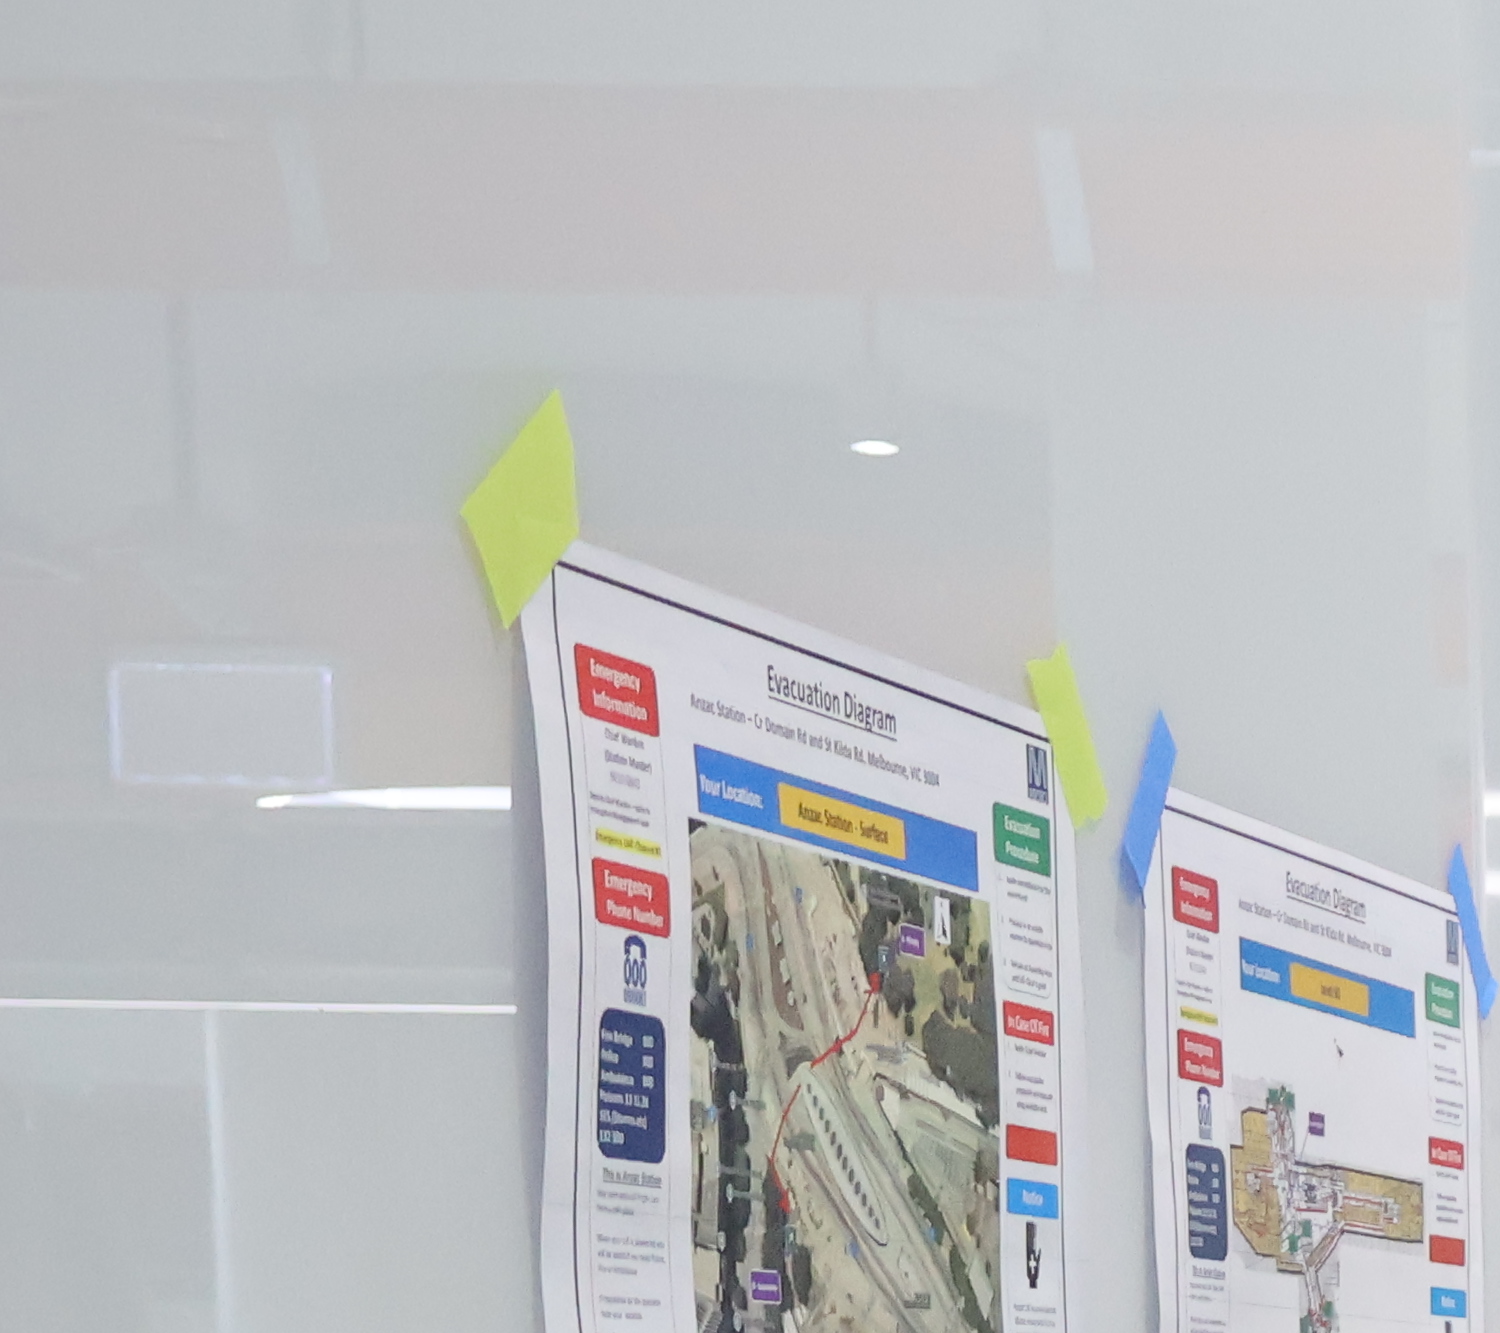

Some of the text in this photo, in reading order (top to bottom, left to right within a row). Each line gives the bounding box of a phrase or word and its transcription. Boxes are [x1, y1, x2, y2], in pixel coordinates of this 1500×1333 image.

[590, 657, 641, 694] Emergency
[592, 688, 648, 721] Information
[767, 665, 898, 735] Evacuation Diagram
[690, 693, 715, 715] Anzac
[715, 700, 746, 724] Station
[765, 717, 796, 742] Domain
[809, 734, 823, 750] and
[825, 735, 832, 751] St
[834, 740, 852, 760] Kilda
[868, 750, 909, 780] Melbourne,
[910, 767, 922, 784] VIC
[699, 774, 764, 809] Your Location:
[797, 802, 822, 824] Anzac
[824, 808, 854, 834] Station
[859, 820, 889, 845] Surface
[604, 868, 653, 902] Emergency
[1286, 871, 1367, 919] Evacuation Diagram
[606, 898, 664, 928] Phone Number
